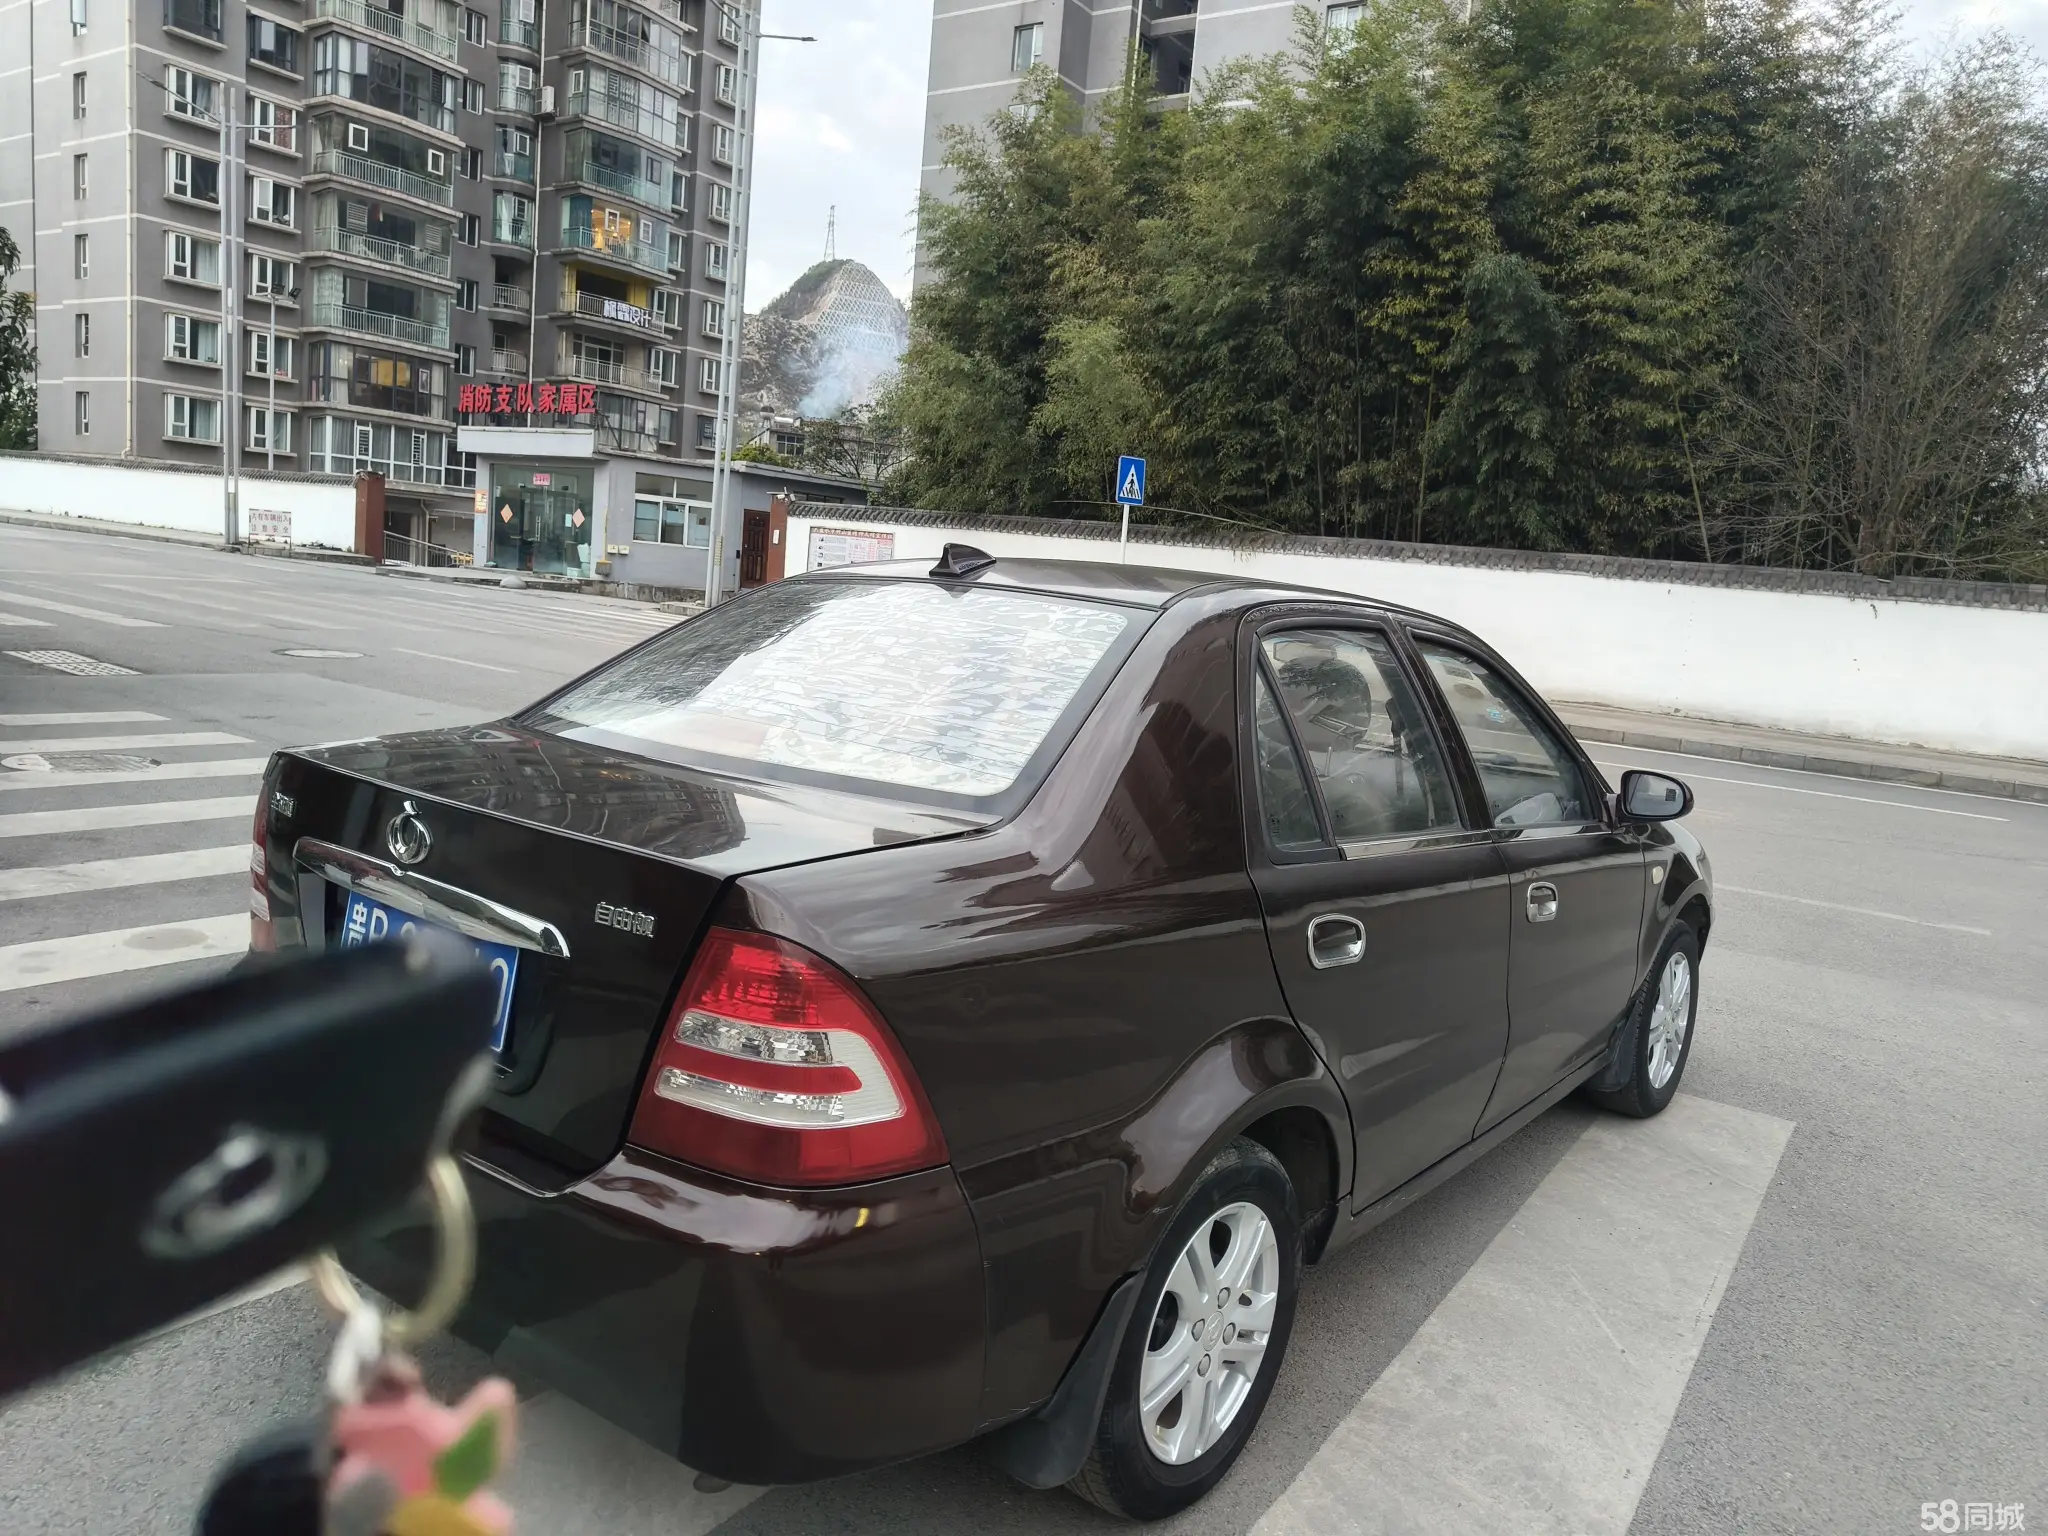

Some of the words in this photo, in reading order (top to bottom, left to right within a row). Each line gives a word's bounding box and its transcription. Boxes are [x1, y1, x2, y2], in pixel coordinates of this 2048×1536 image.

[458, 383, 597, 415] 消防支队家属区
